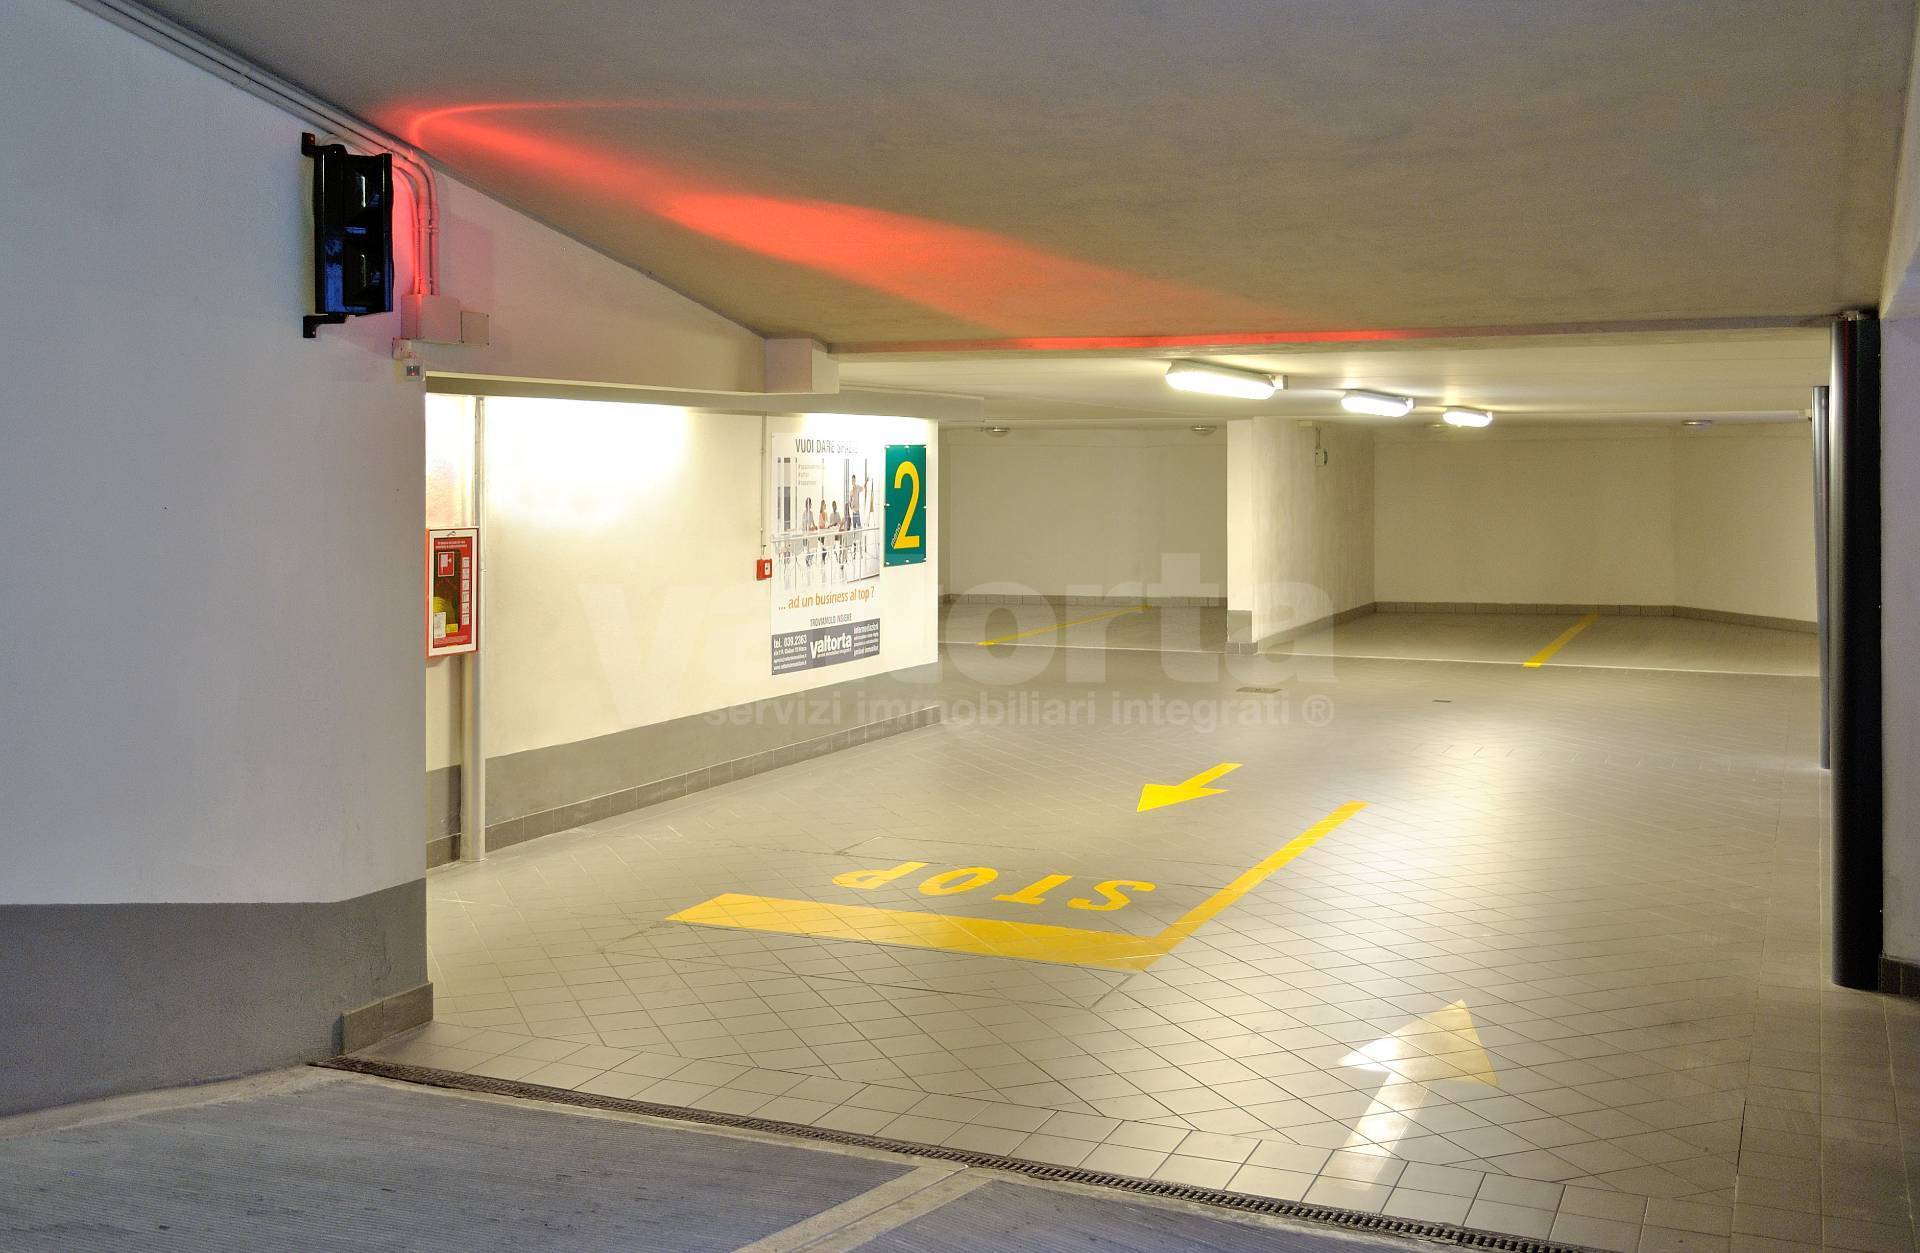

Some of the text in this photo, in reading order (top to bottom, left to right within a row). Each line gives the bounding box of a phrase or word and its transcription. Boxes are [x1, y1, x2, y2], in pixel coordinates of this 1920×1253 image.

[795, 438, 814, 453] VUOI
[894, 461, 920, 549] 2
[788, 596, 800, 609] ad
[801, 596, 813, 608] un
[815, 591, 850, 605] business
[850, 588, 857, 600] al
[831, 861, 1157, 912] STOP
